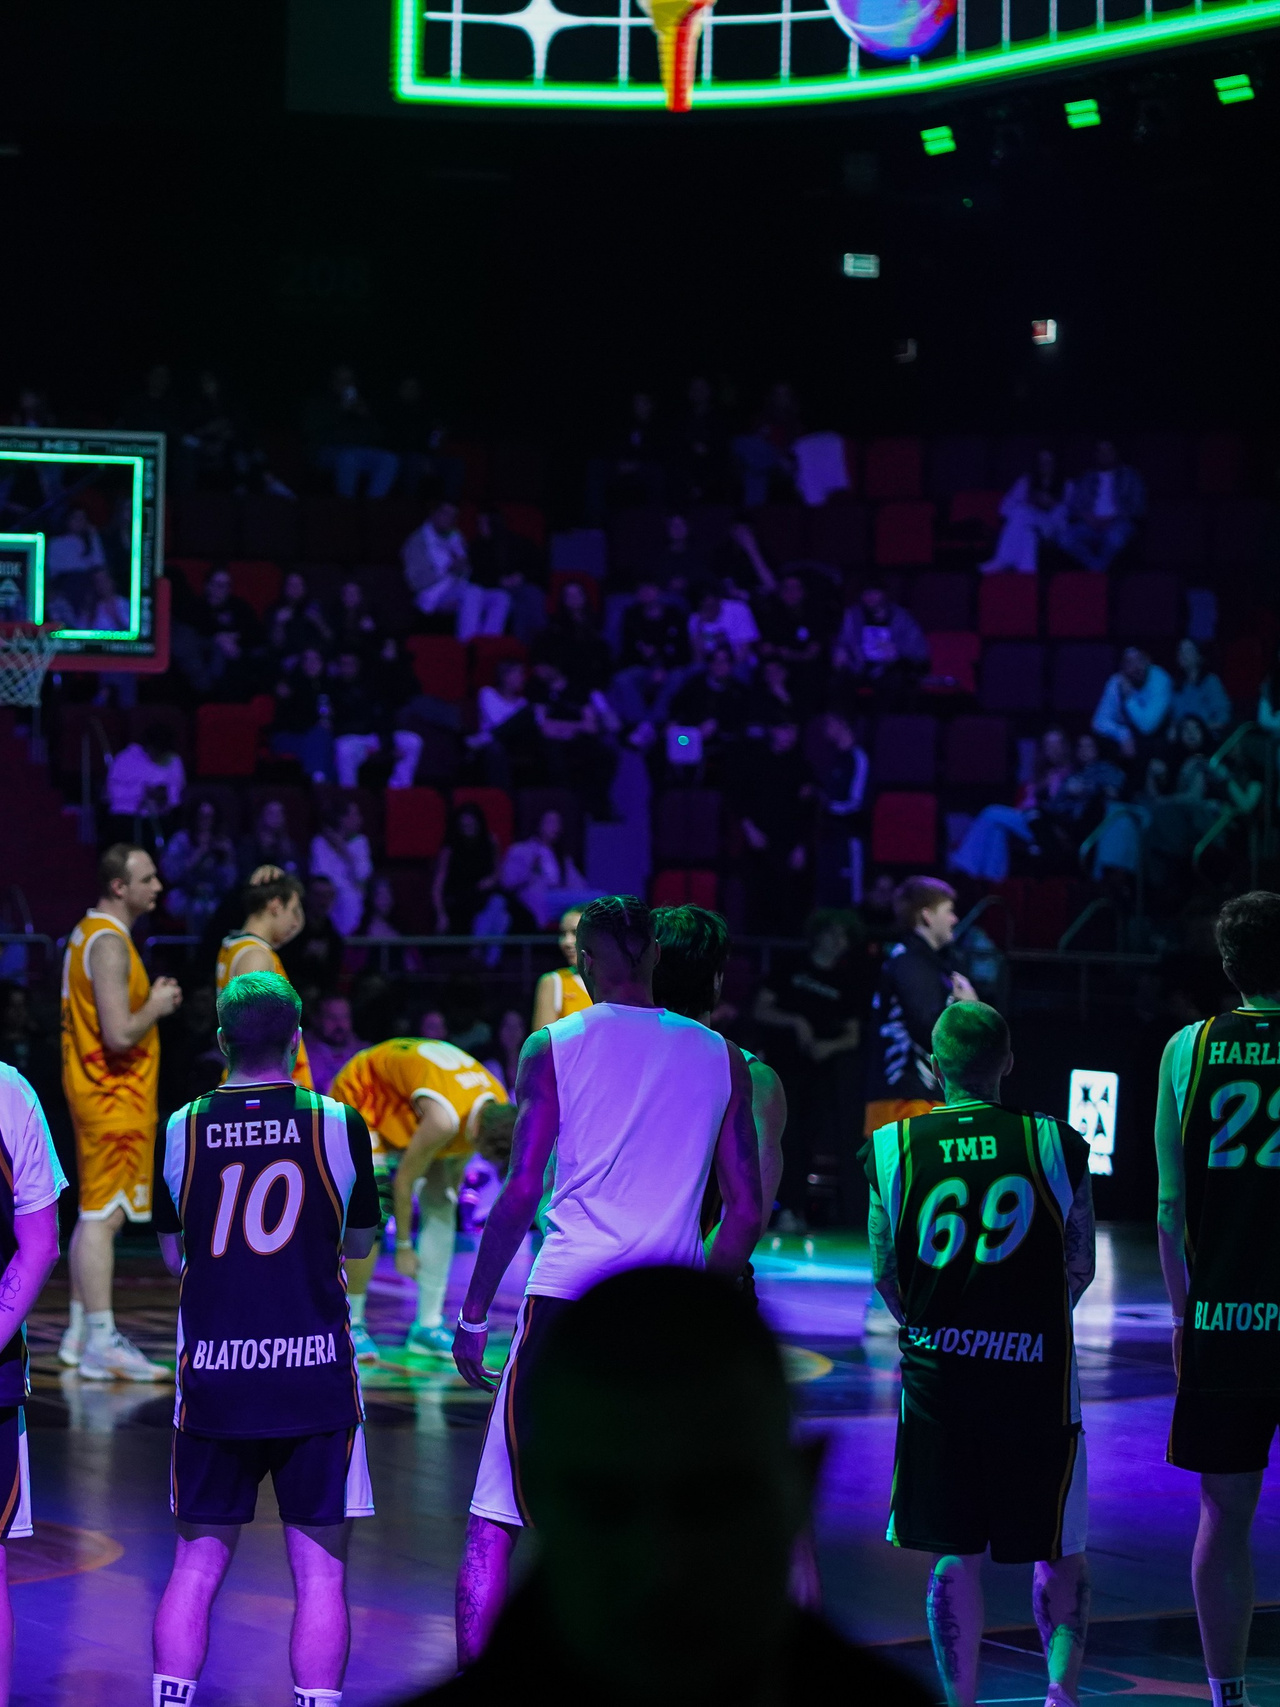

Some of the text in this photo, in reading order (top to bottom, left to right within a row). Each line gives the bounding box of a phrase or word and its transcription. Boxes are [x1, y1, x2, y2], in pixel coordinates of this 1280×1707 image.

[1208, 1040, 1280, 1065] HARL
[206, 1118, 301, 1149] CHEBA
[939, 1135, 998, 1164] YMB
[210, 1158, 306, 1259] 10
[916, 1173, 1037, 1270] 69
[1194, 1300, 1280, 1332] BLATOSP
[193, 1333, 337, 1370] BLATOSPHERA
